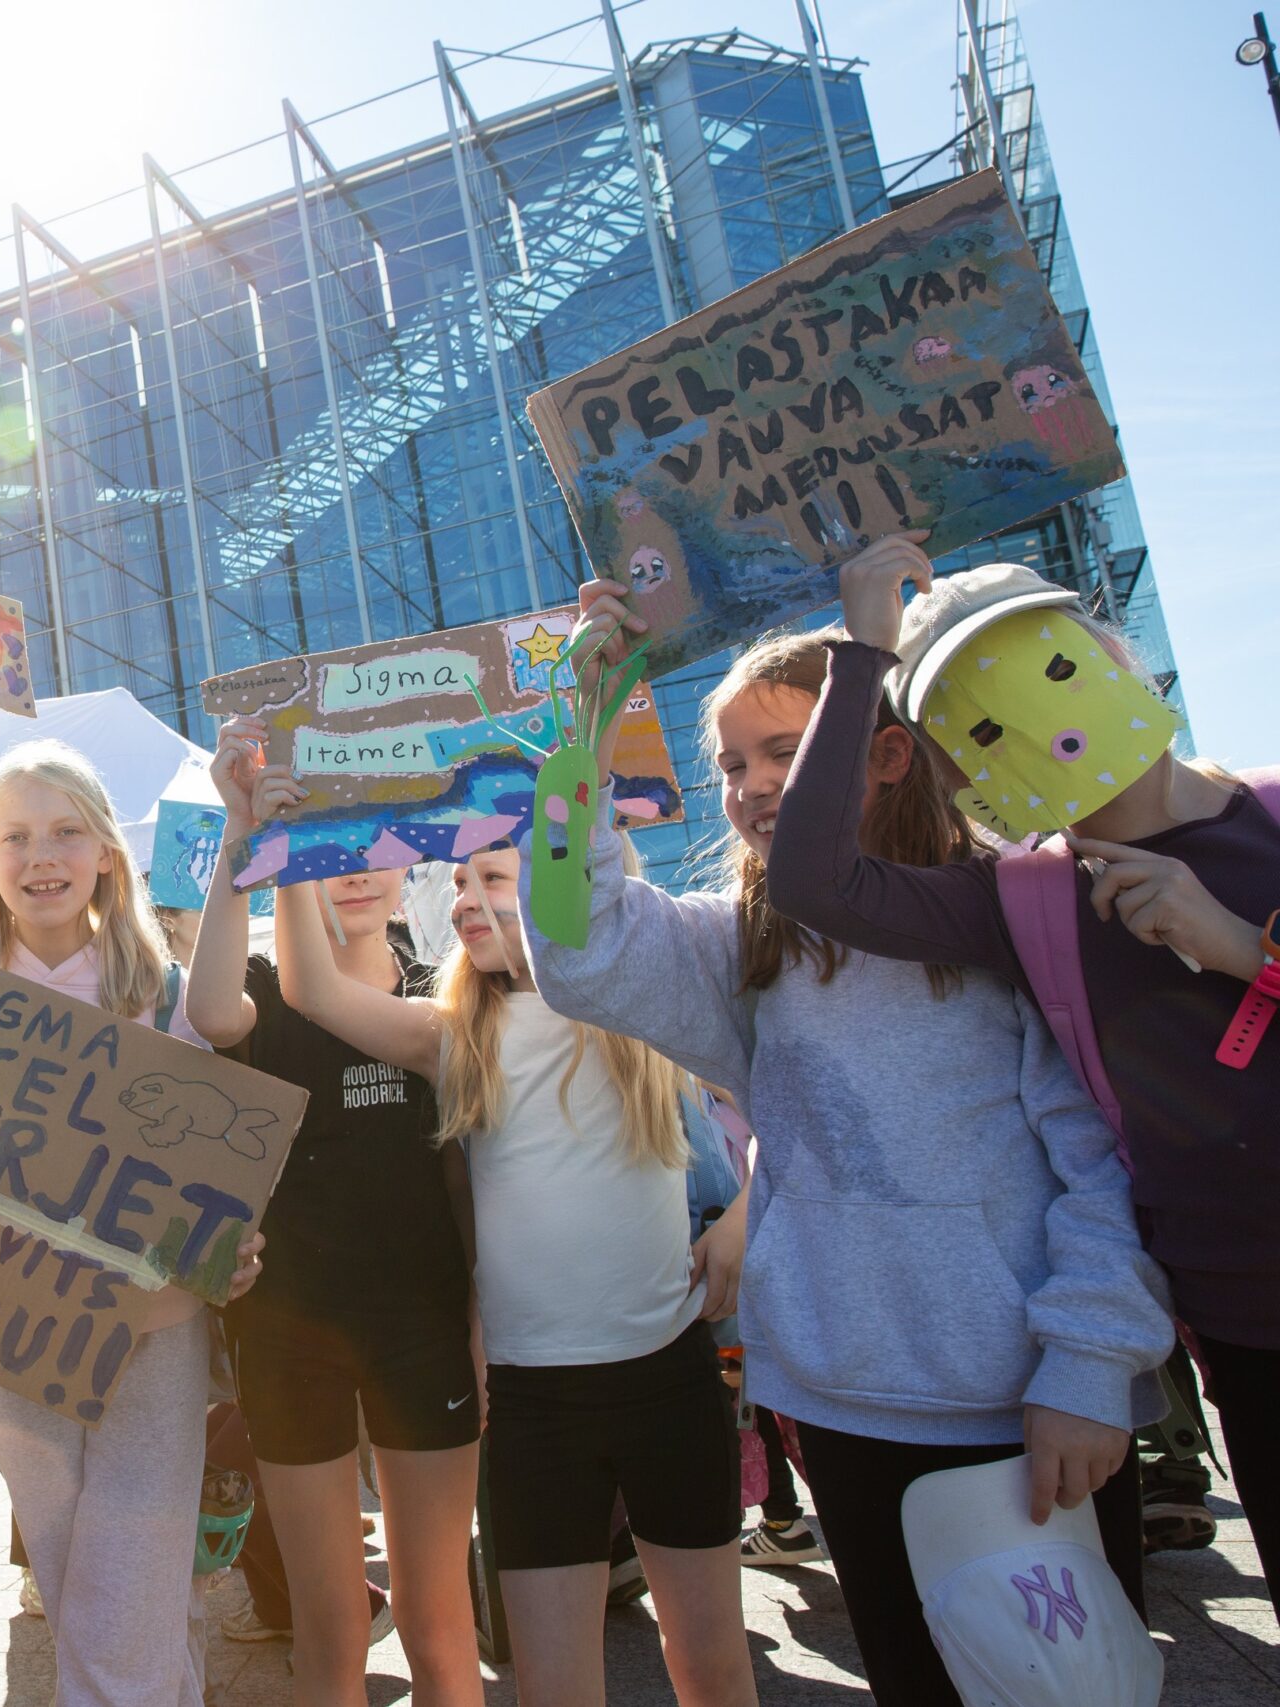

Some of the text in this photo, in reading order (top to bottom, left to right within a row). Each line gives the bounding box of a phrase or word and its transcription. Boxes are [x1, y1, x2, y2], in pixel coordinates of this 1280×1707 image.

[582, 266, 987, 455] PELASTAKAA
[659, 377, 864, 484] VAUVA
[346, 662, 458, 696] Sigma
[307, 736, 446, 764] Itämeri
